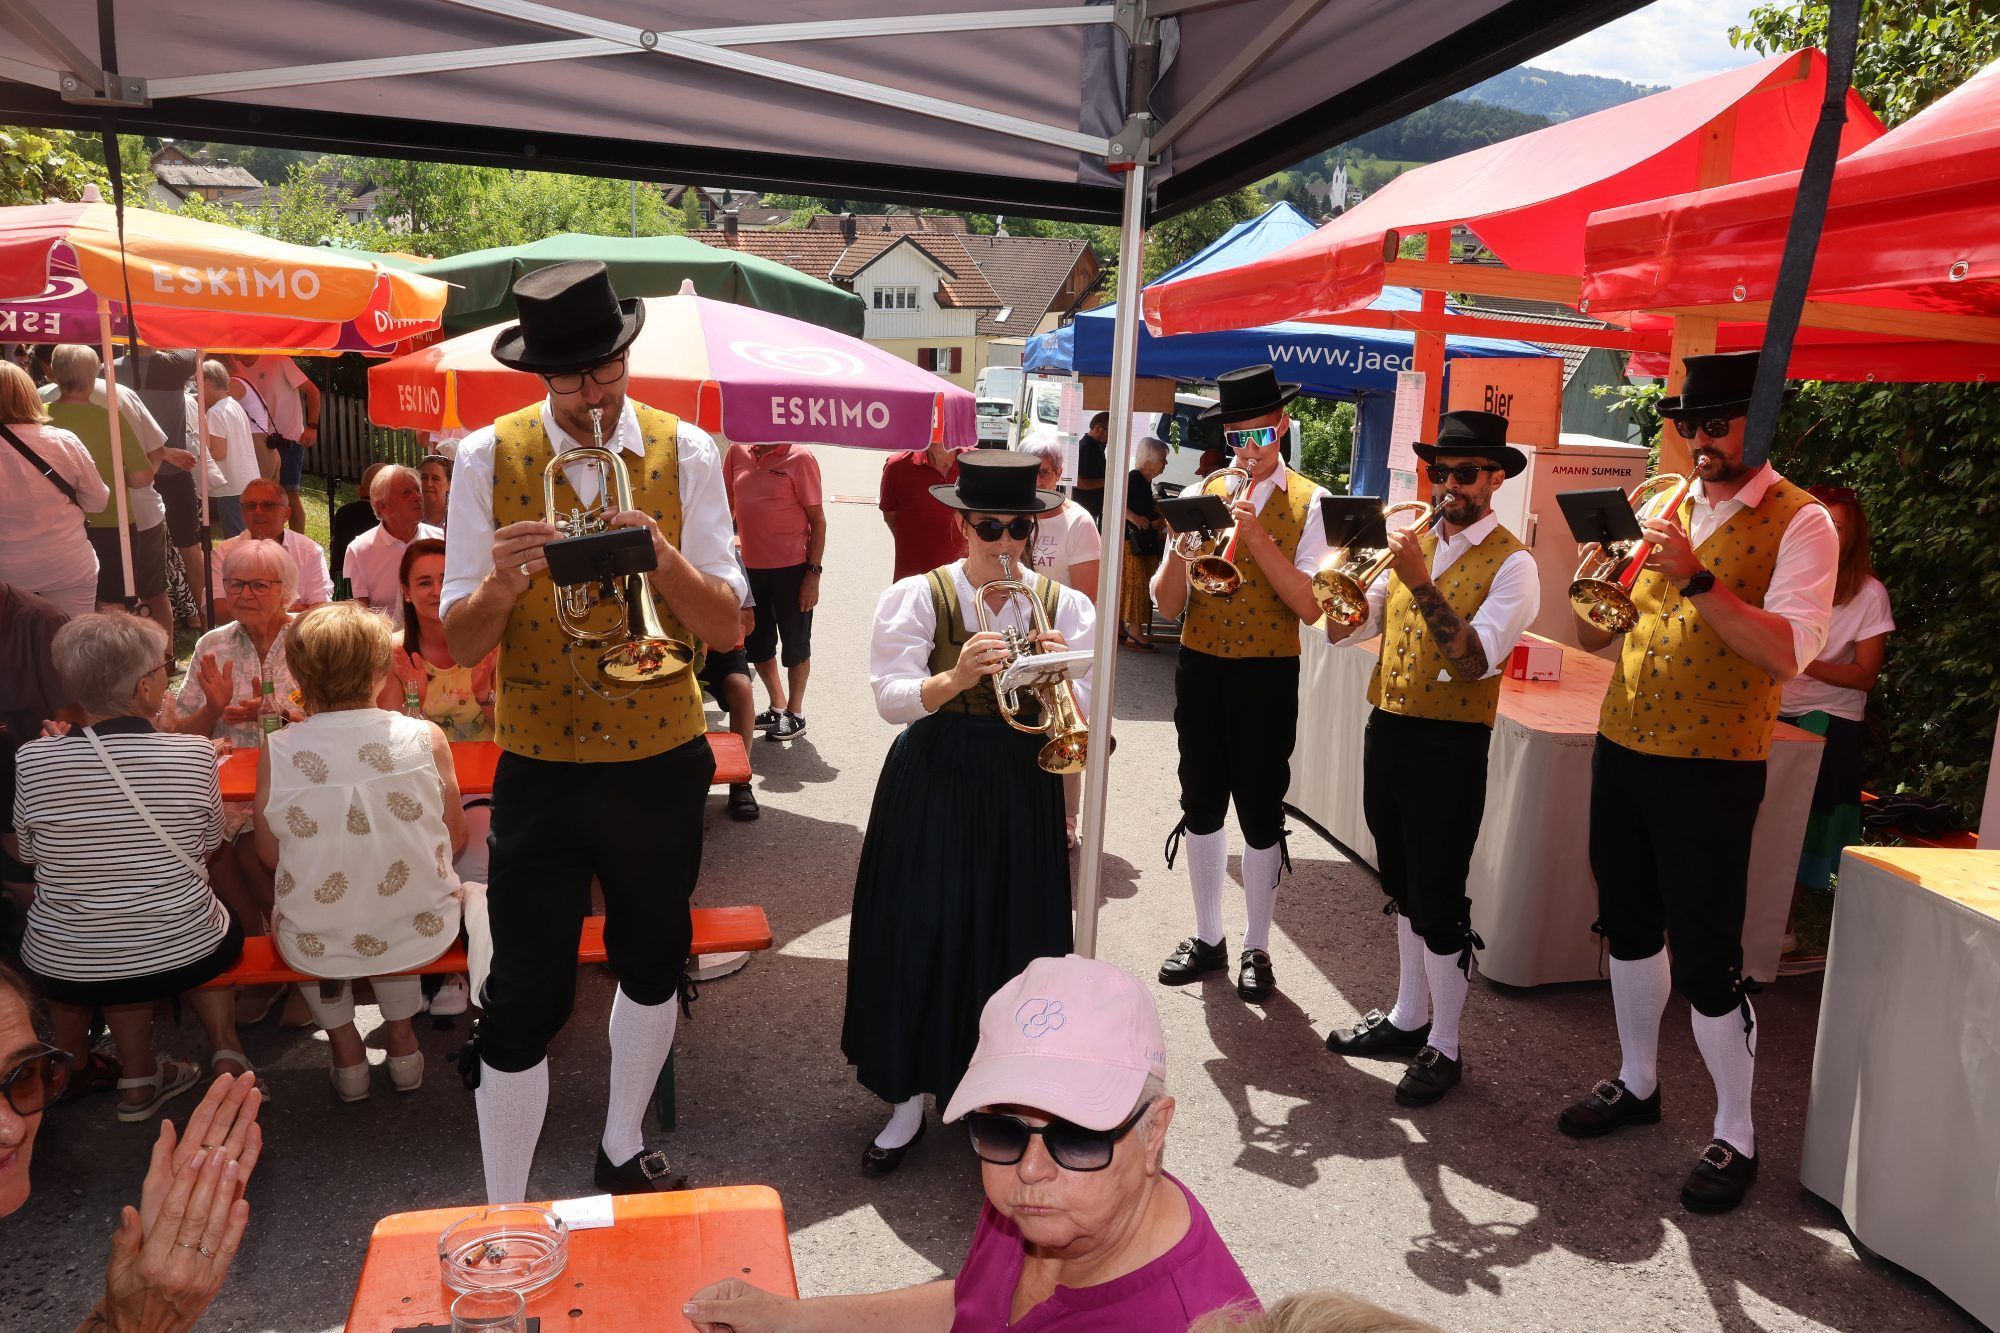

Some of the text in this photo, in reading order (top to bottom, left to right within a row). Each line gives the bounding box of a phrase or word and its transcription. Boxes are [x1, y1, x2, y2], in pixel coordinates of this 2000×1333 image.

[151, 264, 320, 301] ESKIMO
[398, 385, 440, 415] ESKIMO
[771, 396, 890, 429] ESKIMO
[1484, 384, 1514, 417] Bier
[1552, 465, 1632, 477] AMANN SUMMER
